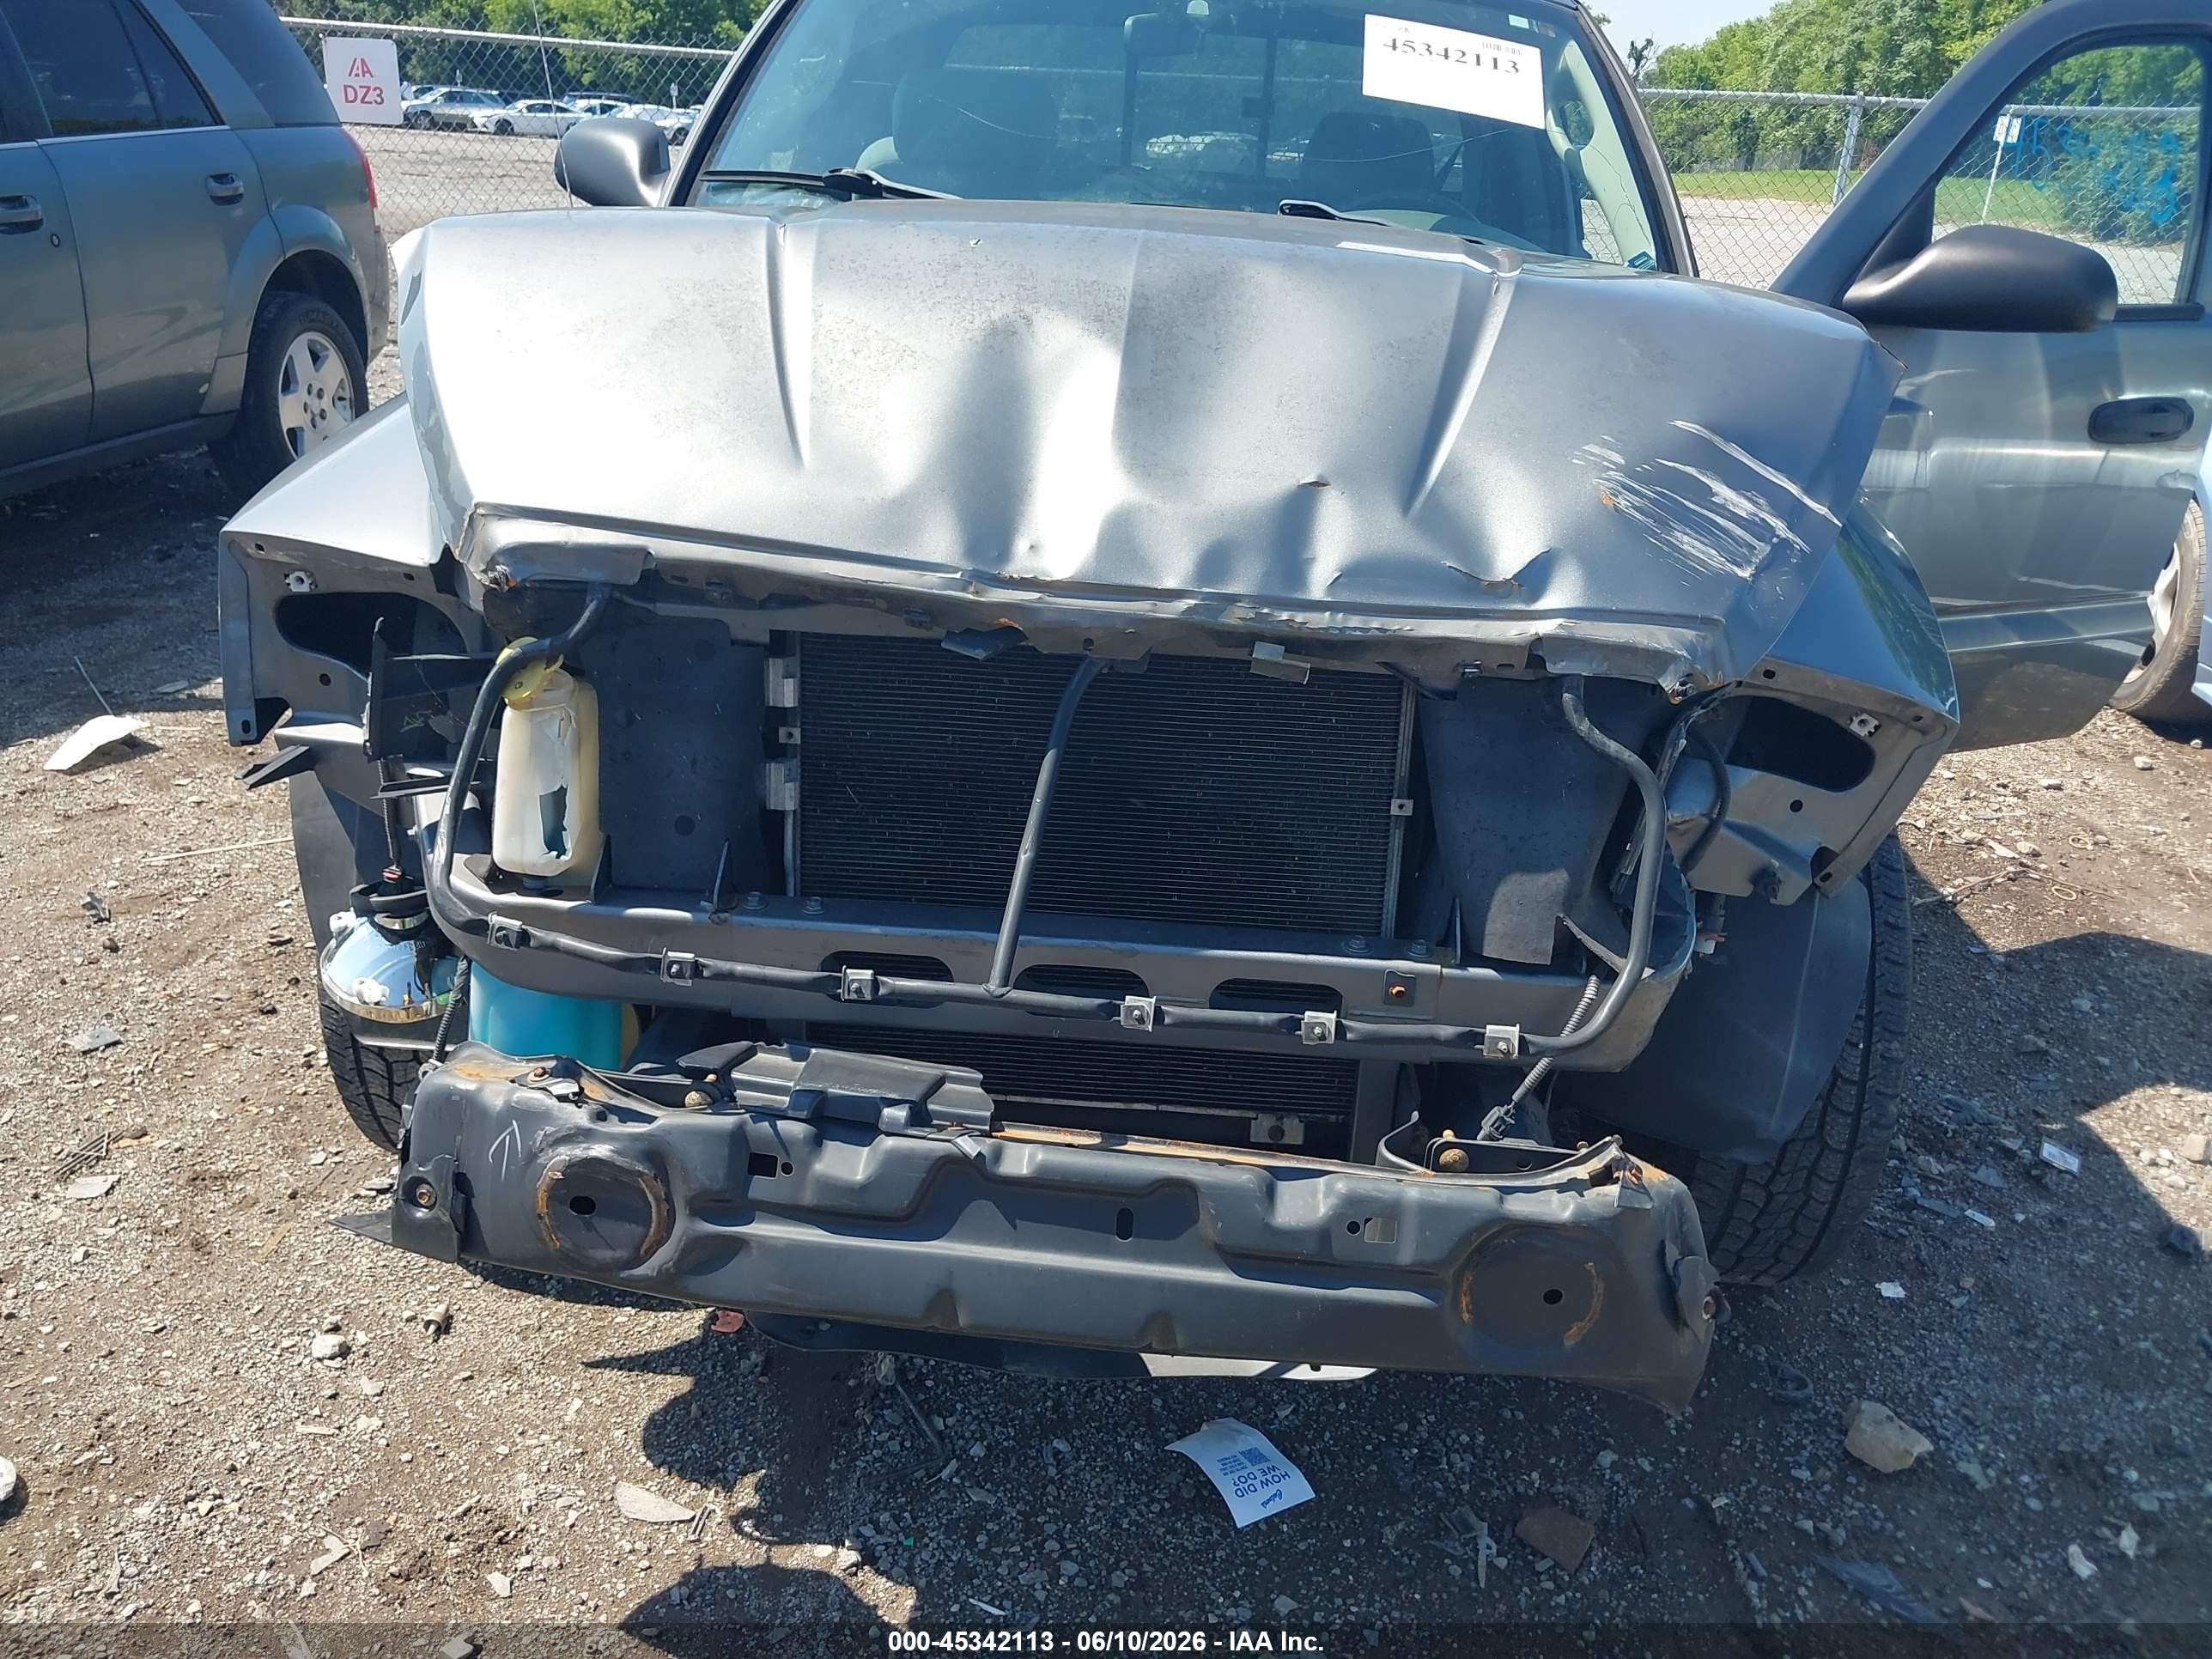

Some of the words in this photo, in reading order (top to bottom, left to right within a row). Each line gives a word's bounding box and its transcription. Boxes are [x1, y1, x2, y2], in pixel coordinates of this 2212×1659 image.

[1383, 38, 1519, 75] 45342113
[343, 84, 385, 105] DZ3
[1232, 1472, 1258, 1487] DO?
[1257, 1465, 1281, 1479] WE
[1261, 1471, 1291, 1490] HOW
[1235, 1484, 1258, 1498] DID
